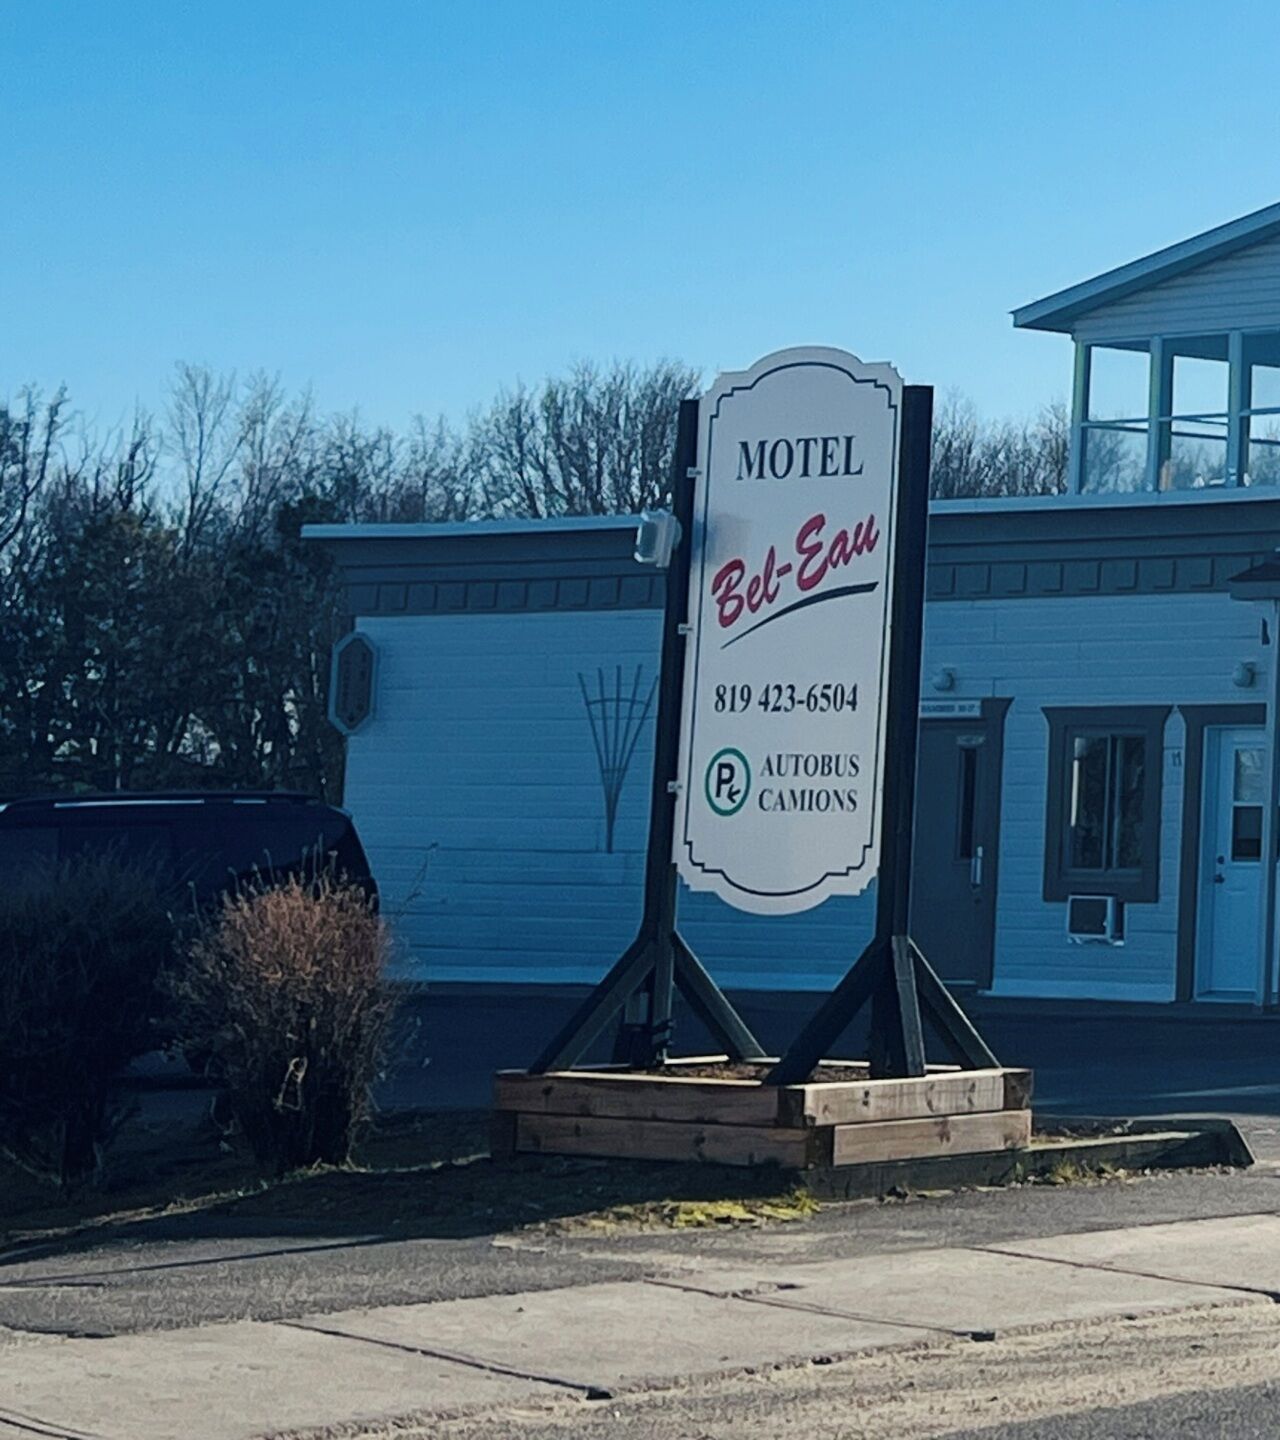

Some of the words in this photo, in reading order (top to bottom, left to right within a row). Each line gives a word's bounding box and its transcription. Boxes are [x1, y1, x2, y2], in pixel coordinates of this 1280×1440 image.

[736, 435, 863, 481] MOTEL
[711, 514, 880, 628] Bel-Eau
[714, 685, 751, 713] 819
[758, 684, 858, 713] 423-6504
[760, 753, 860, 778] AUTOBUS
[758, 789, 858, 813] CAMIONS
